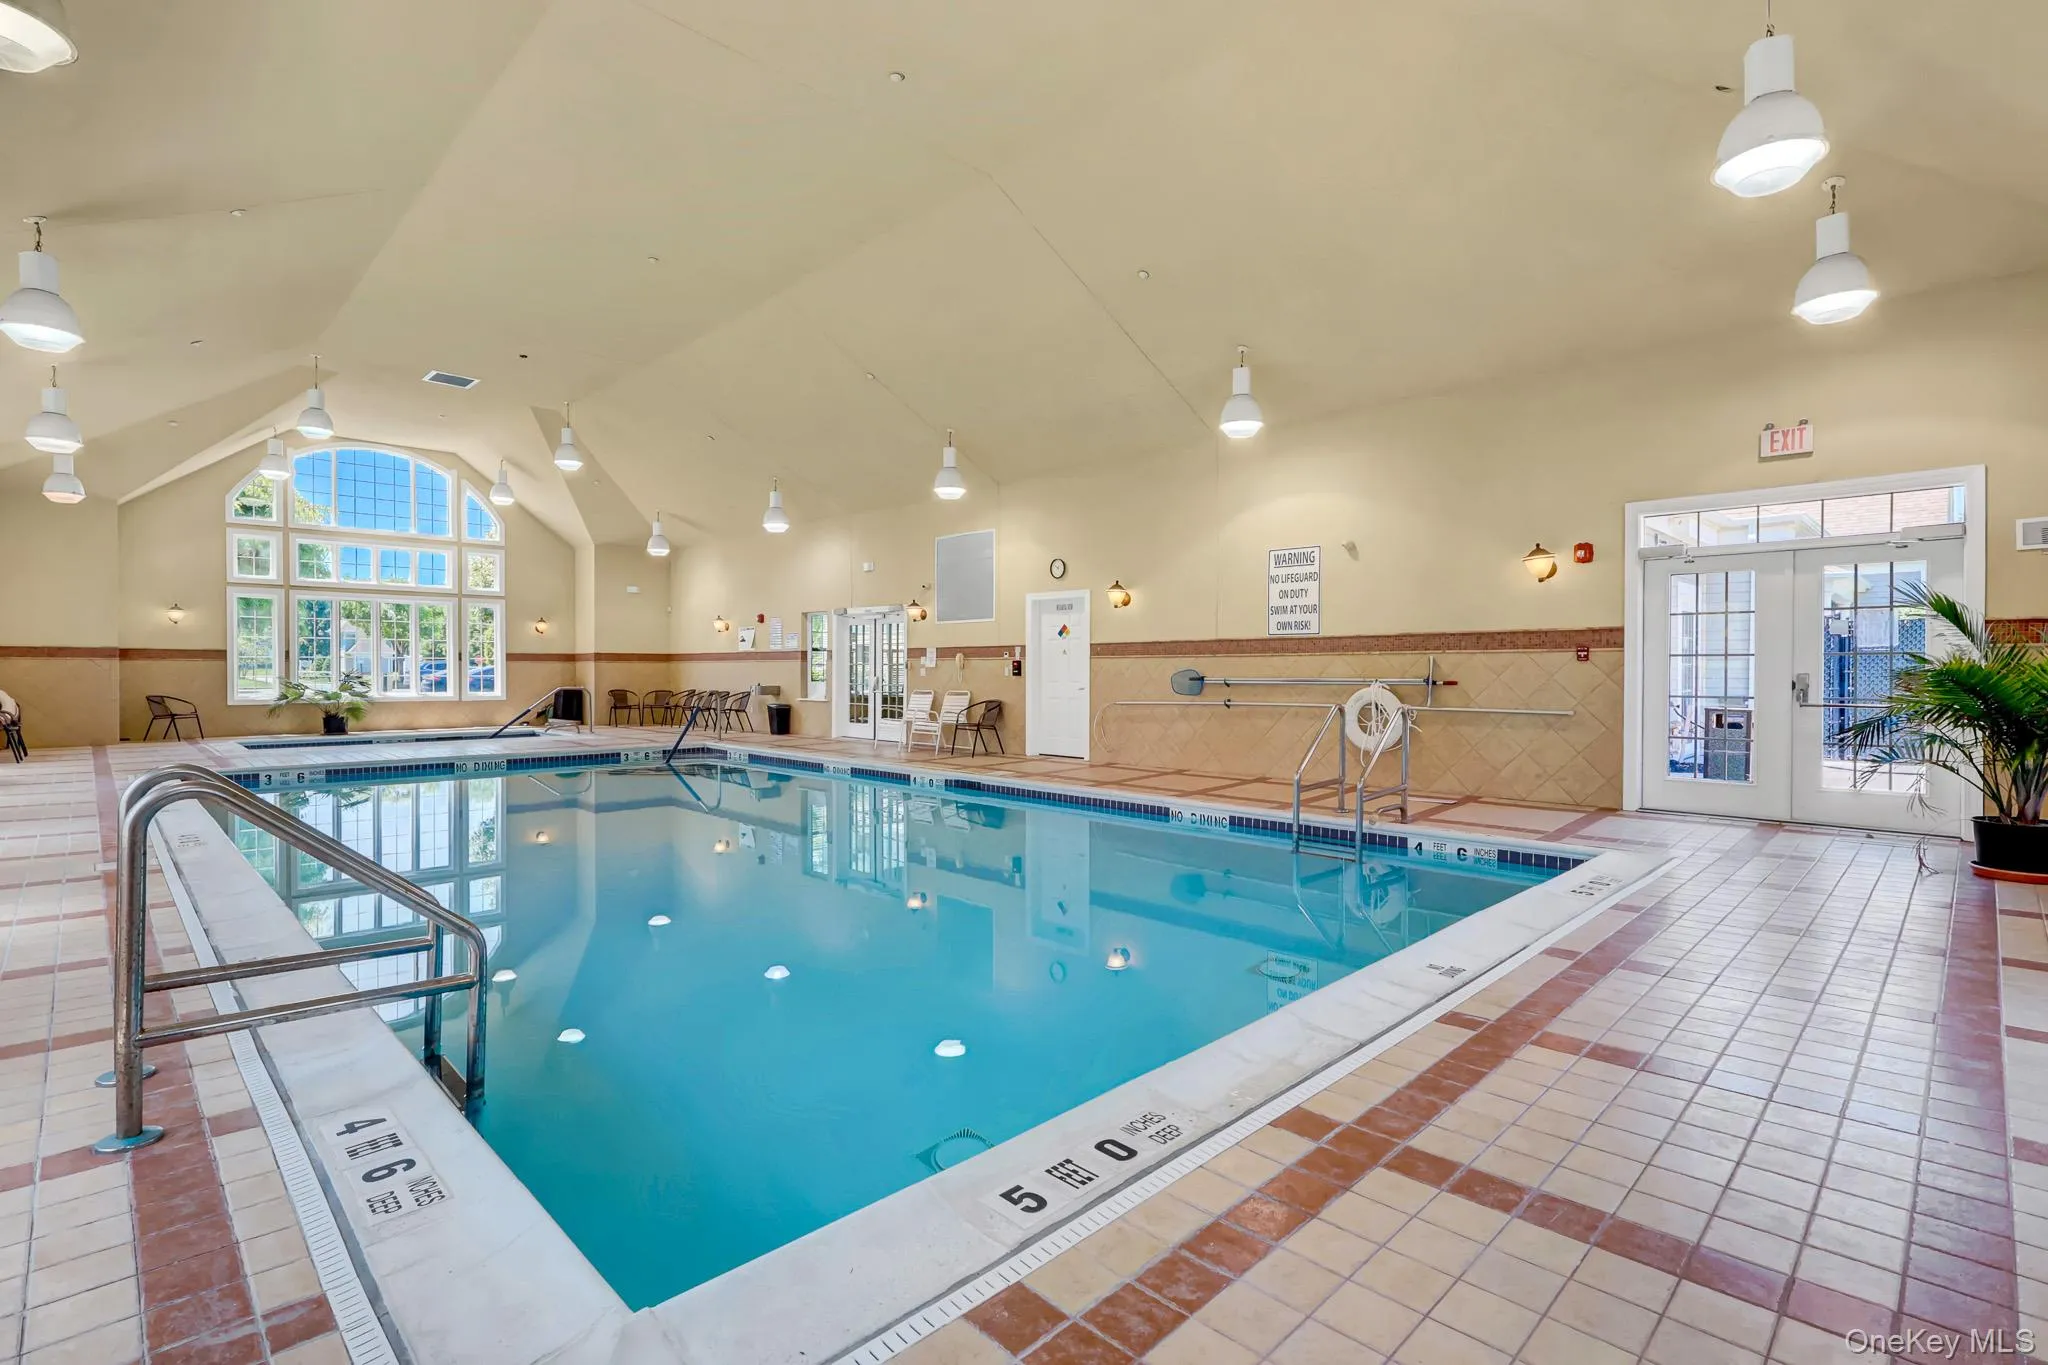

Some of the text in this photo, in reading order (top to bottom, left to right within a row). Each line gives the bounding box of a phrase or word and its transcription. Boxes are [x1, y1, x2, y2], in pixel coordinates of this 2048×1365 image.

[1770, 427, 1806, 452] EXIT
[1274, 551, 1315, 566] WARNING
[1270, 572, 1318, 584] NO LIFEGUARD
[1279, 588, 1308, 599] ON DUTY
[1270, 604, 1317, 615] SWIM AT YOUR
[1277, 620, 1311, 631] OWN RISK!
[456, 762, 467, 772] NO
[264, 774, 272, 786] 3
[297, 773, 305, 784] 6
[1171, 810, 1183, 822] NO
[1433, 842, 1447, 852] FEET
[1474, 848, 1496, 859] INCHES
[336, 1117, 387, 1136] 4
[1147, 1124, 1183, 1145] DEEP
[344, 1132, 404, 1160] FEET
[362, 1158, 416, 1183] 6
[999, 1111, 1167, 1214] 5 FEET 0 INCHES
[366, 1190, 402, 1215] DEEP
